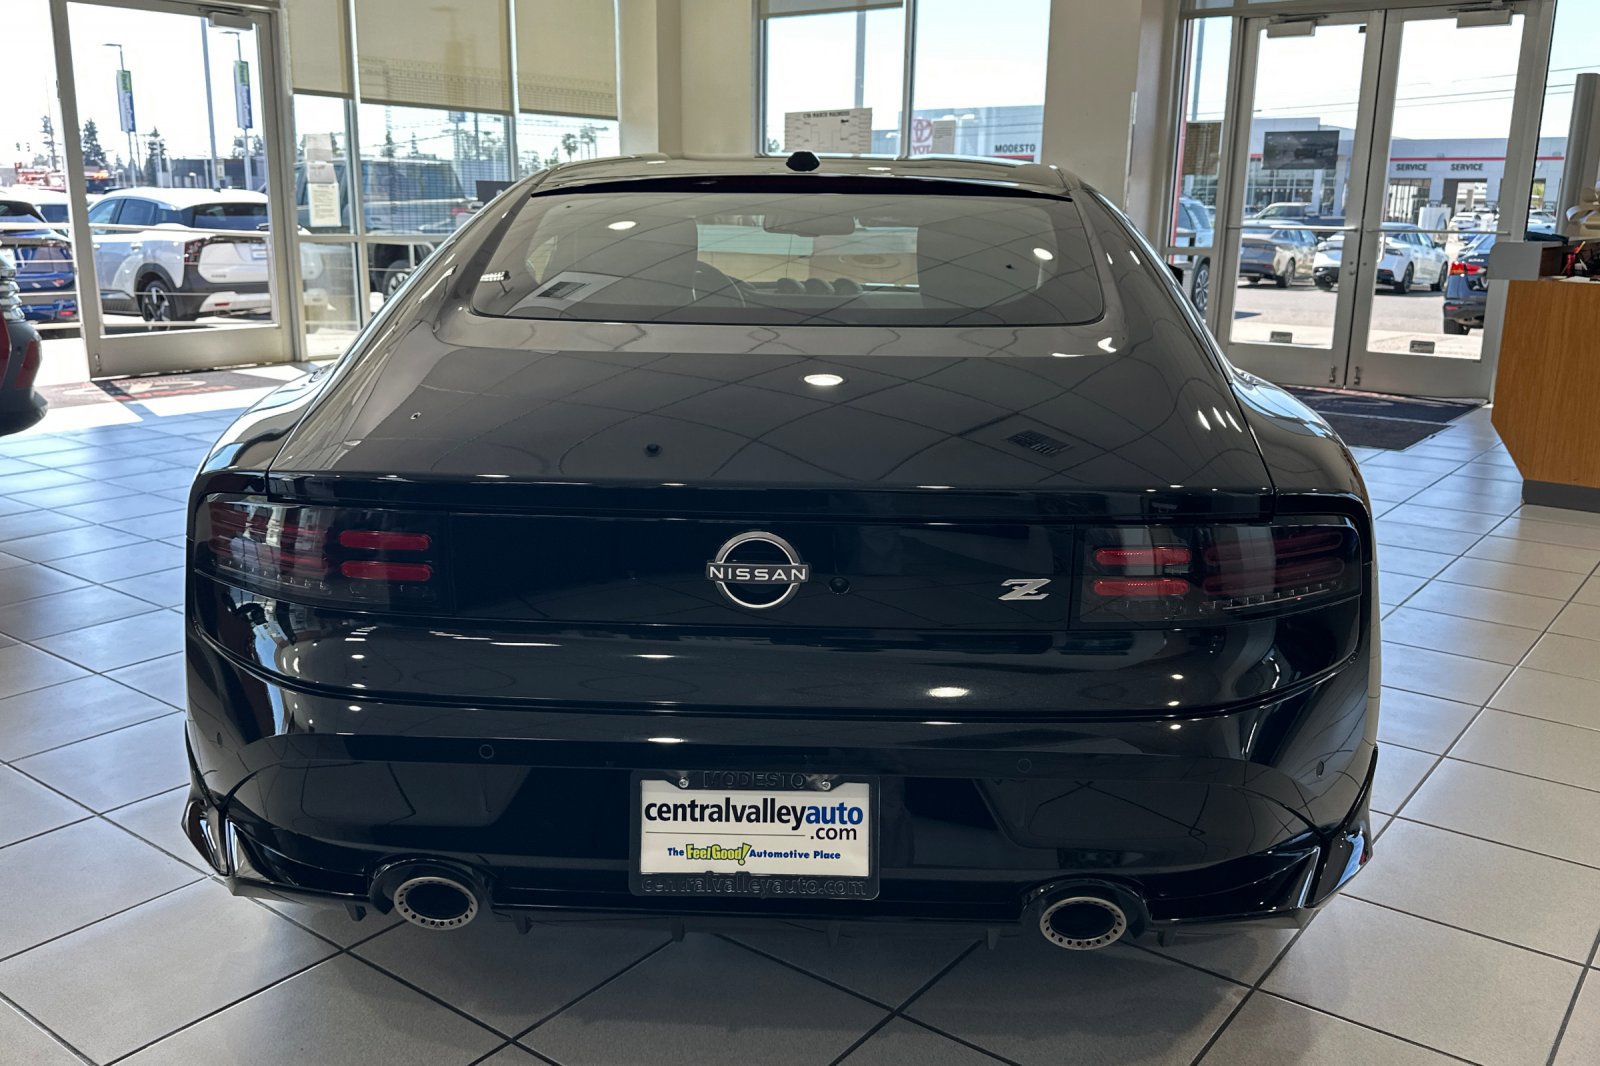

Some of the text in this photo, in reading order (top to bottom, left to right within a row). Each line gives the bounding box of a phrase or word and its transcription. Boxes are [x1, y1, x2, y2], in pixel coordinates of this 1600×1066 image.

[994, 143, 1036, 153] MODESTO
[1396, 163, 1428, 171] SERVICE
[1451, 163, 1484, 171] SERVICE
[709, 566, 806, 581] NISSAN
[998, 578, 1052, 601] Z
[703, 770, 808, 789] MODESTO
[644, 797, 864, 830] centralvalleyauto
[810, 827, 857, 840] .com
[667, 847, 684, 857] The
[749, 848, 810, 859] Automotive
[813, 850, 841, 860] Place
[641, 871, 867, 899] centralvalleyauto.com
